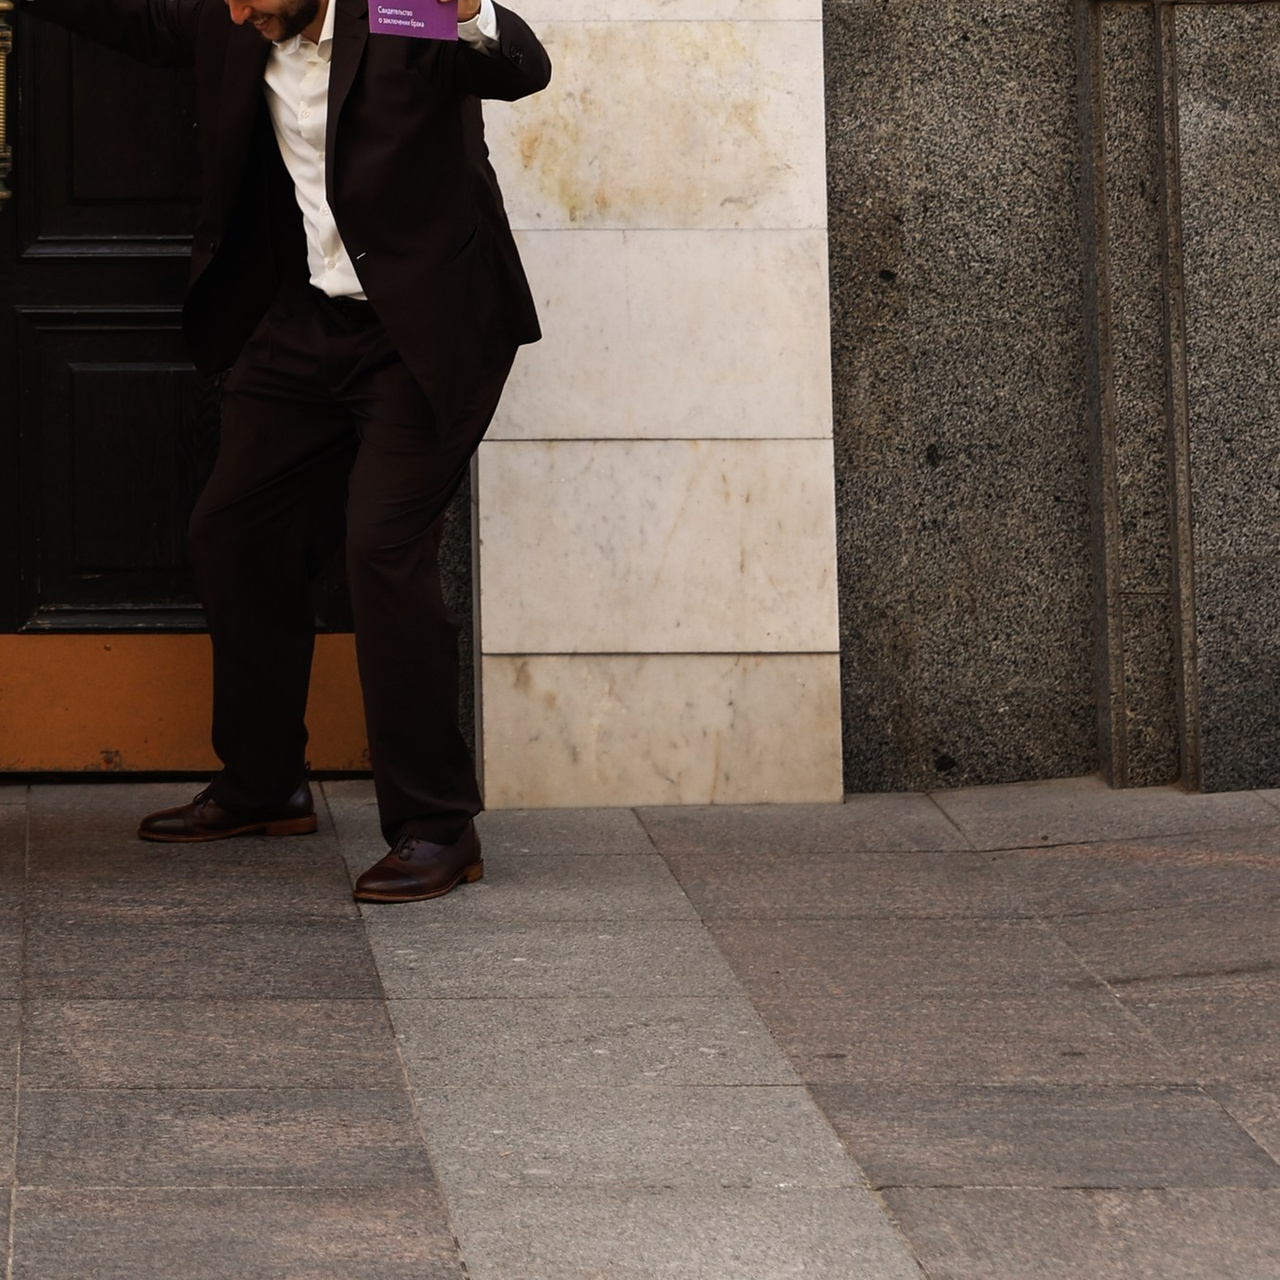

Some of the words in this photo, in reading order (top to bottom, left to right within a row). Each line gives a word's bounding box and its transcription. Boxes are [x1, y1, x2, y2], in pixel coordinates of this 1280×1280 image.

[377, 6, 413, 16] Свидетельство
[383, 18, 410, 26] заключении
[410, 19, 425, 28] брака
